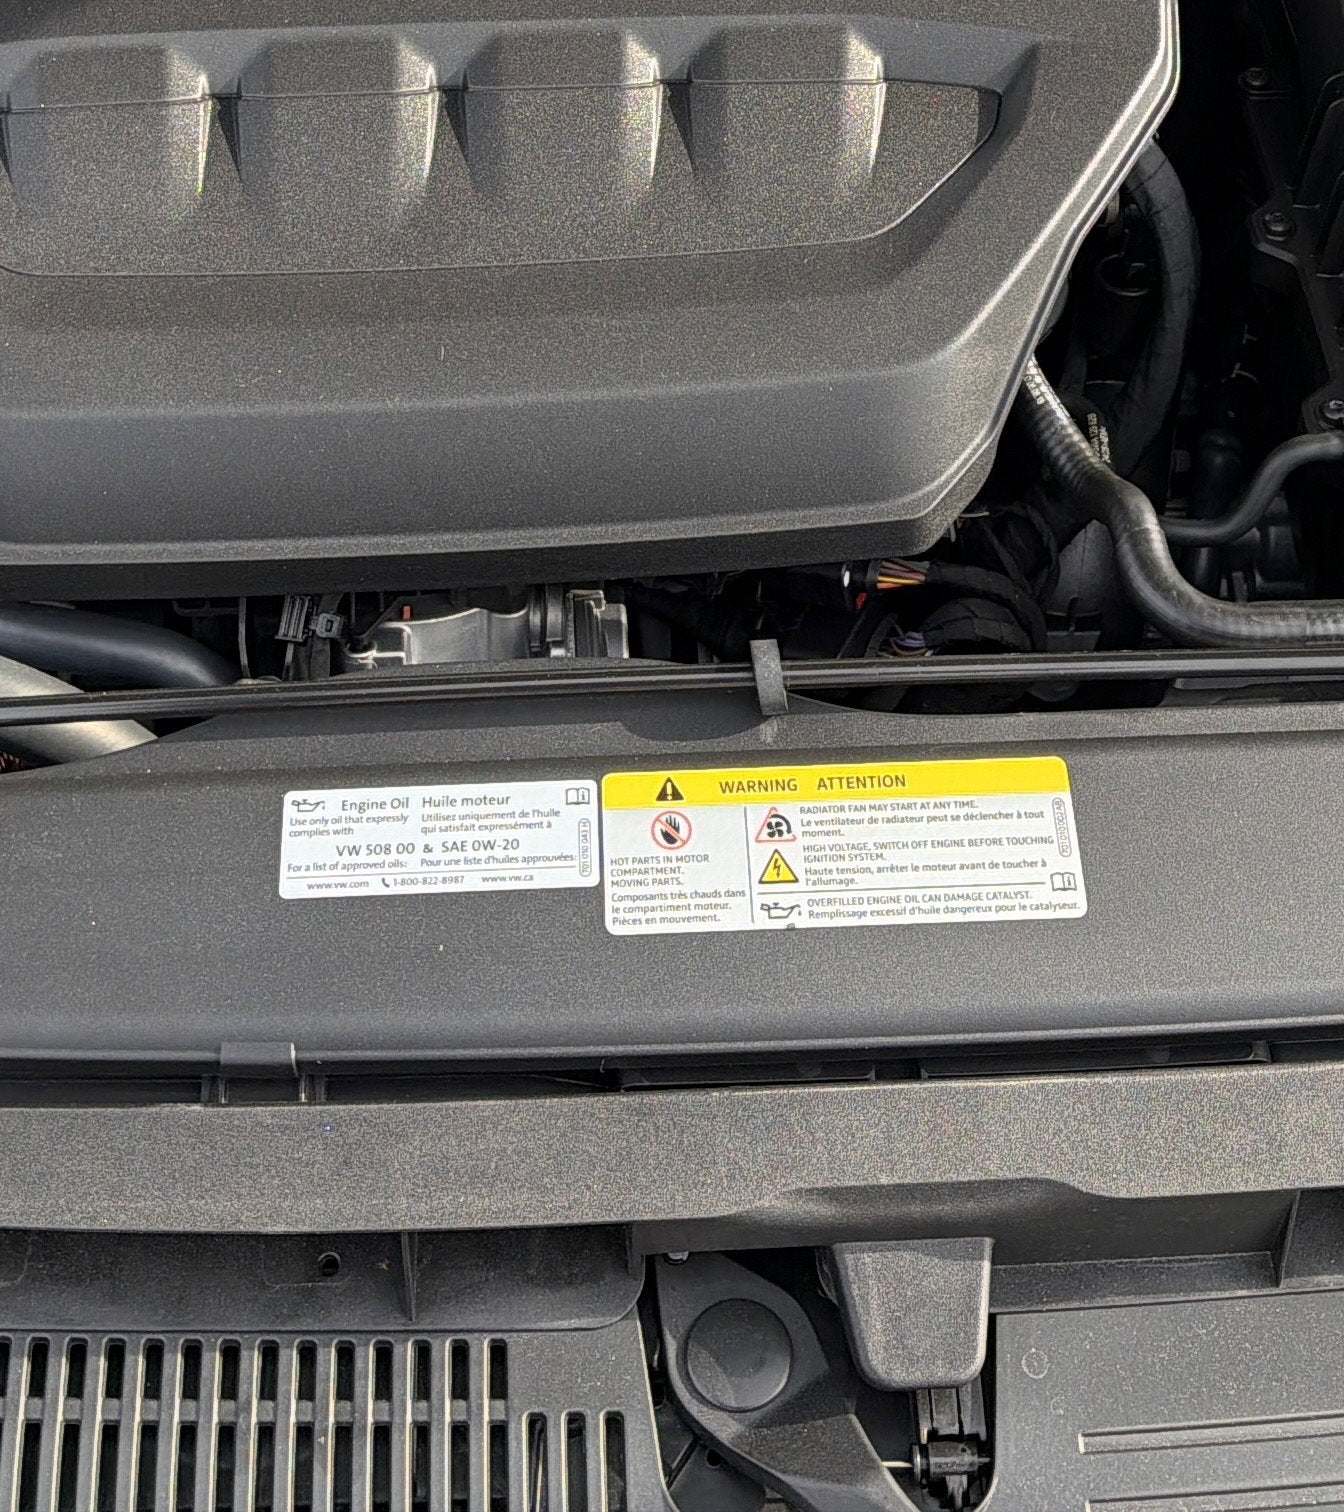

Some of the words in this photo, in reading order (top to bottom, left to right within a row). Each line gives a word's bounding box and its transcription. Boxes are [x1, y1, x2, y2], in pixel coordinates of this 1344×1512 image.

[719, 778, 798, 794] WARNING
[817, 774, 906, 790] ATTENTION
[342, 798, 387, 814] Engine
[390, 796, 409, 810] Oil
[422, 795, 457, 808] Huile
[461, 794, 511, 806] moteur
[800, 804, 846, 814] RADIATOR
[848, 804, 866, 813] FAN
[868, 803, 888, 812] MAY
[890, 802, 918, 811] START
[920, 801, 931, 810] AT
[932, 801, 951, 810] ANY
[953, 800, 979, 809] TIME.
[290, 817, 308, 826] Use
[309, 816, 330, 827] only
[331, 815, 342, 825] oil
[344, 815, 364, 828] that
[366, 813, 409, 825] expressly
[421, 813, 456, 822] Utilisez
[458, 810, 516, 822] uniquement
[518, 809, 530, 818] de
[532, 808, 561, 818] l'huile
[800, 818, 812, 827] Le
[814, 817, 865, 826] ventilateur
[867, 816, 879, 825] de
[881, 815, 924, 824] radiateur
[926, 814, 948, 824] peut
[962, 811, 1014, 822] déclencher
[1024, 810, 1045, 819] tout
[289, 828, 330, 839] complies
[332, 826, 354, 836] with
[420, 824, 436, 836] qui
[438, 822, 476, 833] satisfait
[478, 821, 544, 833] expressément
[801, 828, 845, 838] moment.
[336, 844, 362, 857] VW
[366, 843, 392, 856] 508
[396, 842, 415, 854] 00
[423, 844, 433, 854] &
[441, 840, 468, 853] SAE
[472, 838, 520, 852] 0W-20
[802, 844, 826, 853] HIGH
[828, 842, 872, 852] VOLTAGE,
[873, 841, 909, 850] SWITCH
[910, 840, 928, 849] OFF
[931, 838, 966, 849] ENGINE
[968, 837, 1004, 847] BEFORE
[1005, 835, 1054, 846] TOUCHING
[420, 858, 442, 867] Pour
[463, 856, 483, 865] liste
[484, 854, 520, 864] d'huiles
[520, 852, 577, 865] approuvées:
[610, 857, 629, 866] HOT
[632, 856, 661, 865] PARTS
[663, 856, 673, 864] IN
[675, 854, 710, 864] MOTOR
[804, 854, 846, 863] IGNITION
[848, 852, 887, 862] SYSTEM.
[287, 863, 303, 872] For
[312, 862, 327, 871] list
[328, 861, 340, 871] of
[341, 859, 386, 872] approved
[387, 859, 407, 868] oils:
[610, 866, 685, 877] COMPARTMENT.
[804, 867, 834, 876] Haute
[836, 865, 874, 875] tension,
[876, 864, 908, 874] arrêter
[911, 863, 920, 872] le
[922, 864, 957, 872] moteur
[959, 862, 986, 870] avant
[988, 860, 1000, 870] de
[1002, 858, 1038, 869] toucher
[307, 881, 369, 890] www.vw.com
[393, 875, 464, 886] 1-800-822-8987
[481, 874, 534, 883] www.vw.ca
[611, 878, 649, 888] MOVING
[652, 877, 684, 886] PARTS.
[805, 877, 858, 887] l'allumage.
[611, 892, 668, 903] Composants
[670, 890, 688, 900] très
[690, 889, 722, 900] chauds
[724, 888, 746, 898] dans
[807, 896, 864, 908] OVERFILLED
[866, 895, 902, 905] ENGINE
[904, 895, 920, 904] OIL
[922, 894, 942, 903] CAN
[944, 892, 984, 902] DAMAGE
[986, 890, 1032, 901] CATALYST.
[612, 905, 620, 914] le
[622, 903, 692, 915] compartiment
[694, 902, 732, 911] moteur.
[808, 909, 868, 920] Remplissage
[870, 906, 906, 917] excessif
[908, 905, 941, 916] d'huile
[943, 905, 992, 916] dangereux
[995, 904, 1016, 914] pour
[1018, 902, 1028, 911] le
[1029, 901, 1080, 912] catalyseur.
[612, 916, 642, 926] Pièces
[644, 917, 657, 925] en
[659, 914, 721, 924] mouvement.
